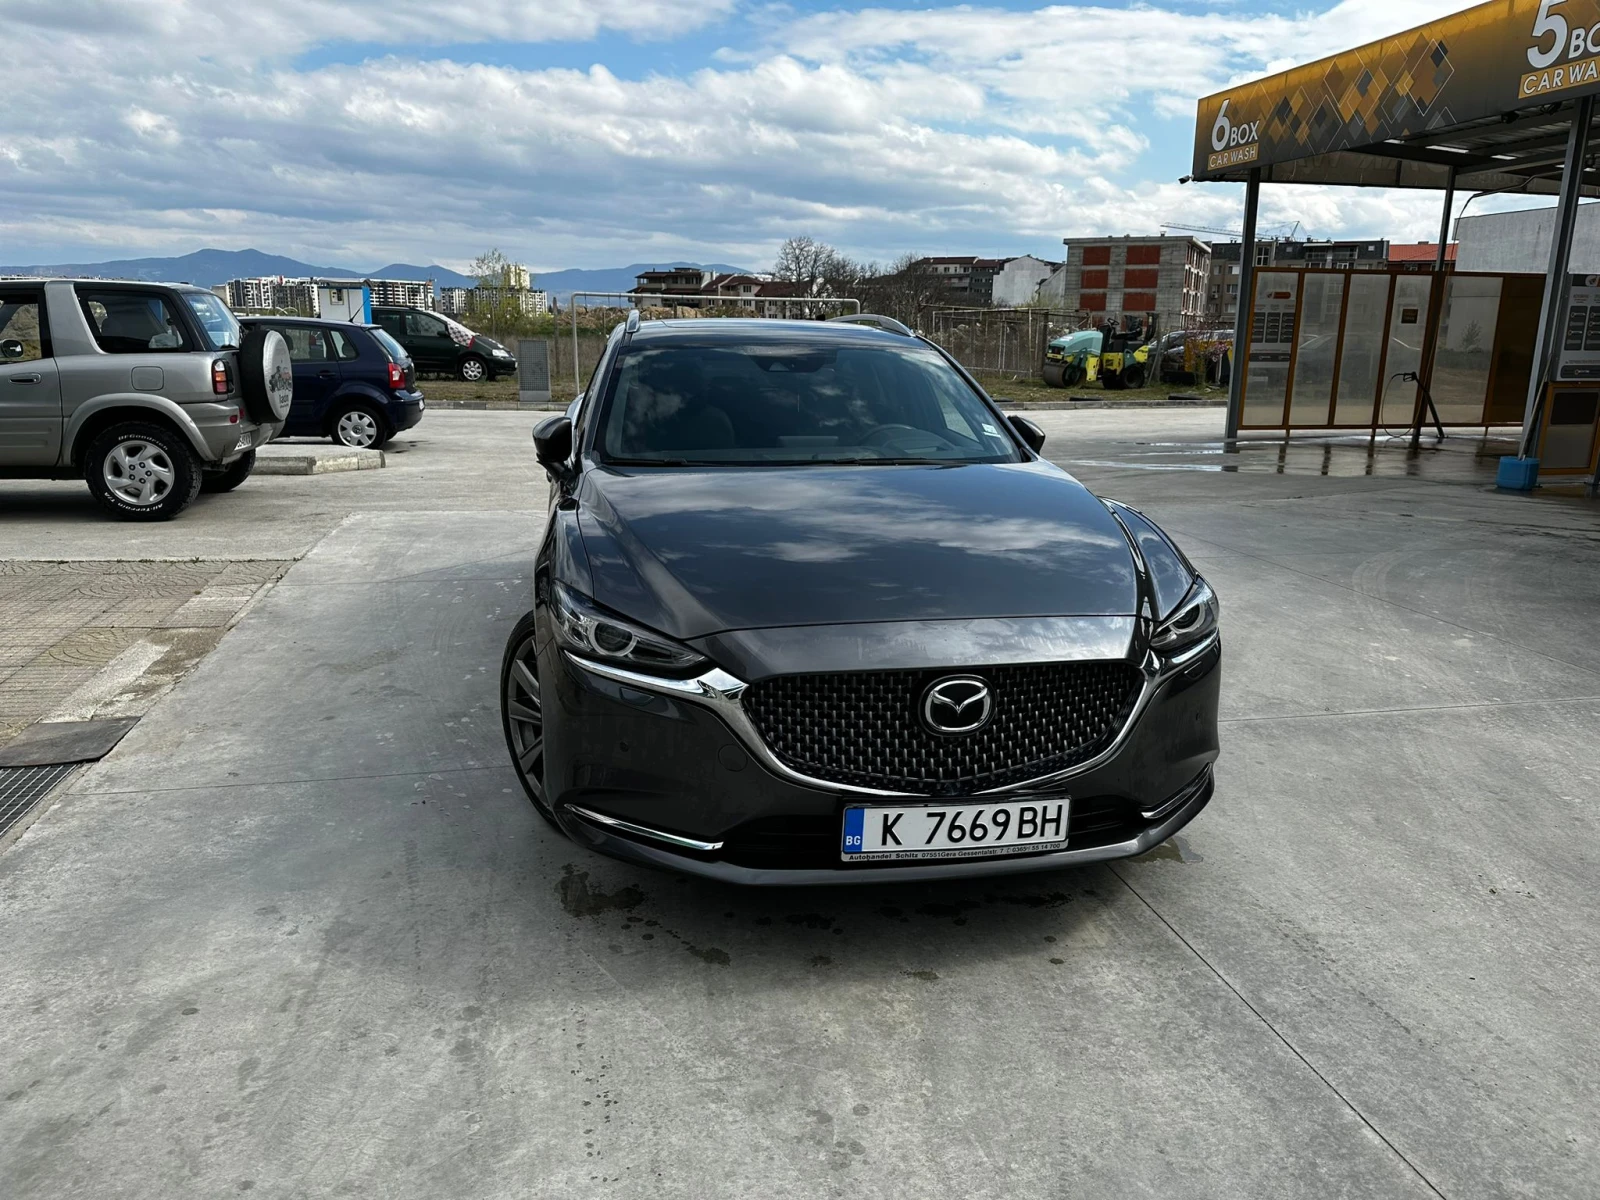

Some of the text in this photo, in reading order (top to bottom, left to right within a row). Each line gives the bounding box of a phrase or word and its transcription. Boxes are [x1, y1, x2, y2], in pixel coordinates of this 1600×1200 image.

[1527, 0, 1568, 69] 5
[1523, 68, 1564, 94] CAR
[1209, 146, 1256, 168] CAR WASH
[845, 835, 862, 847] BG
[880, 812, 905, 846] K
[848, 853, 892, 861] Autohandel
